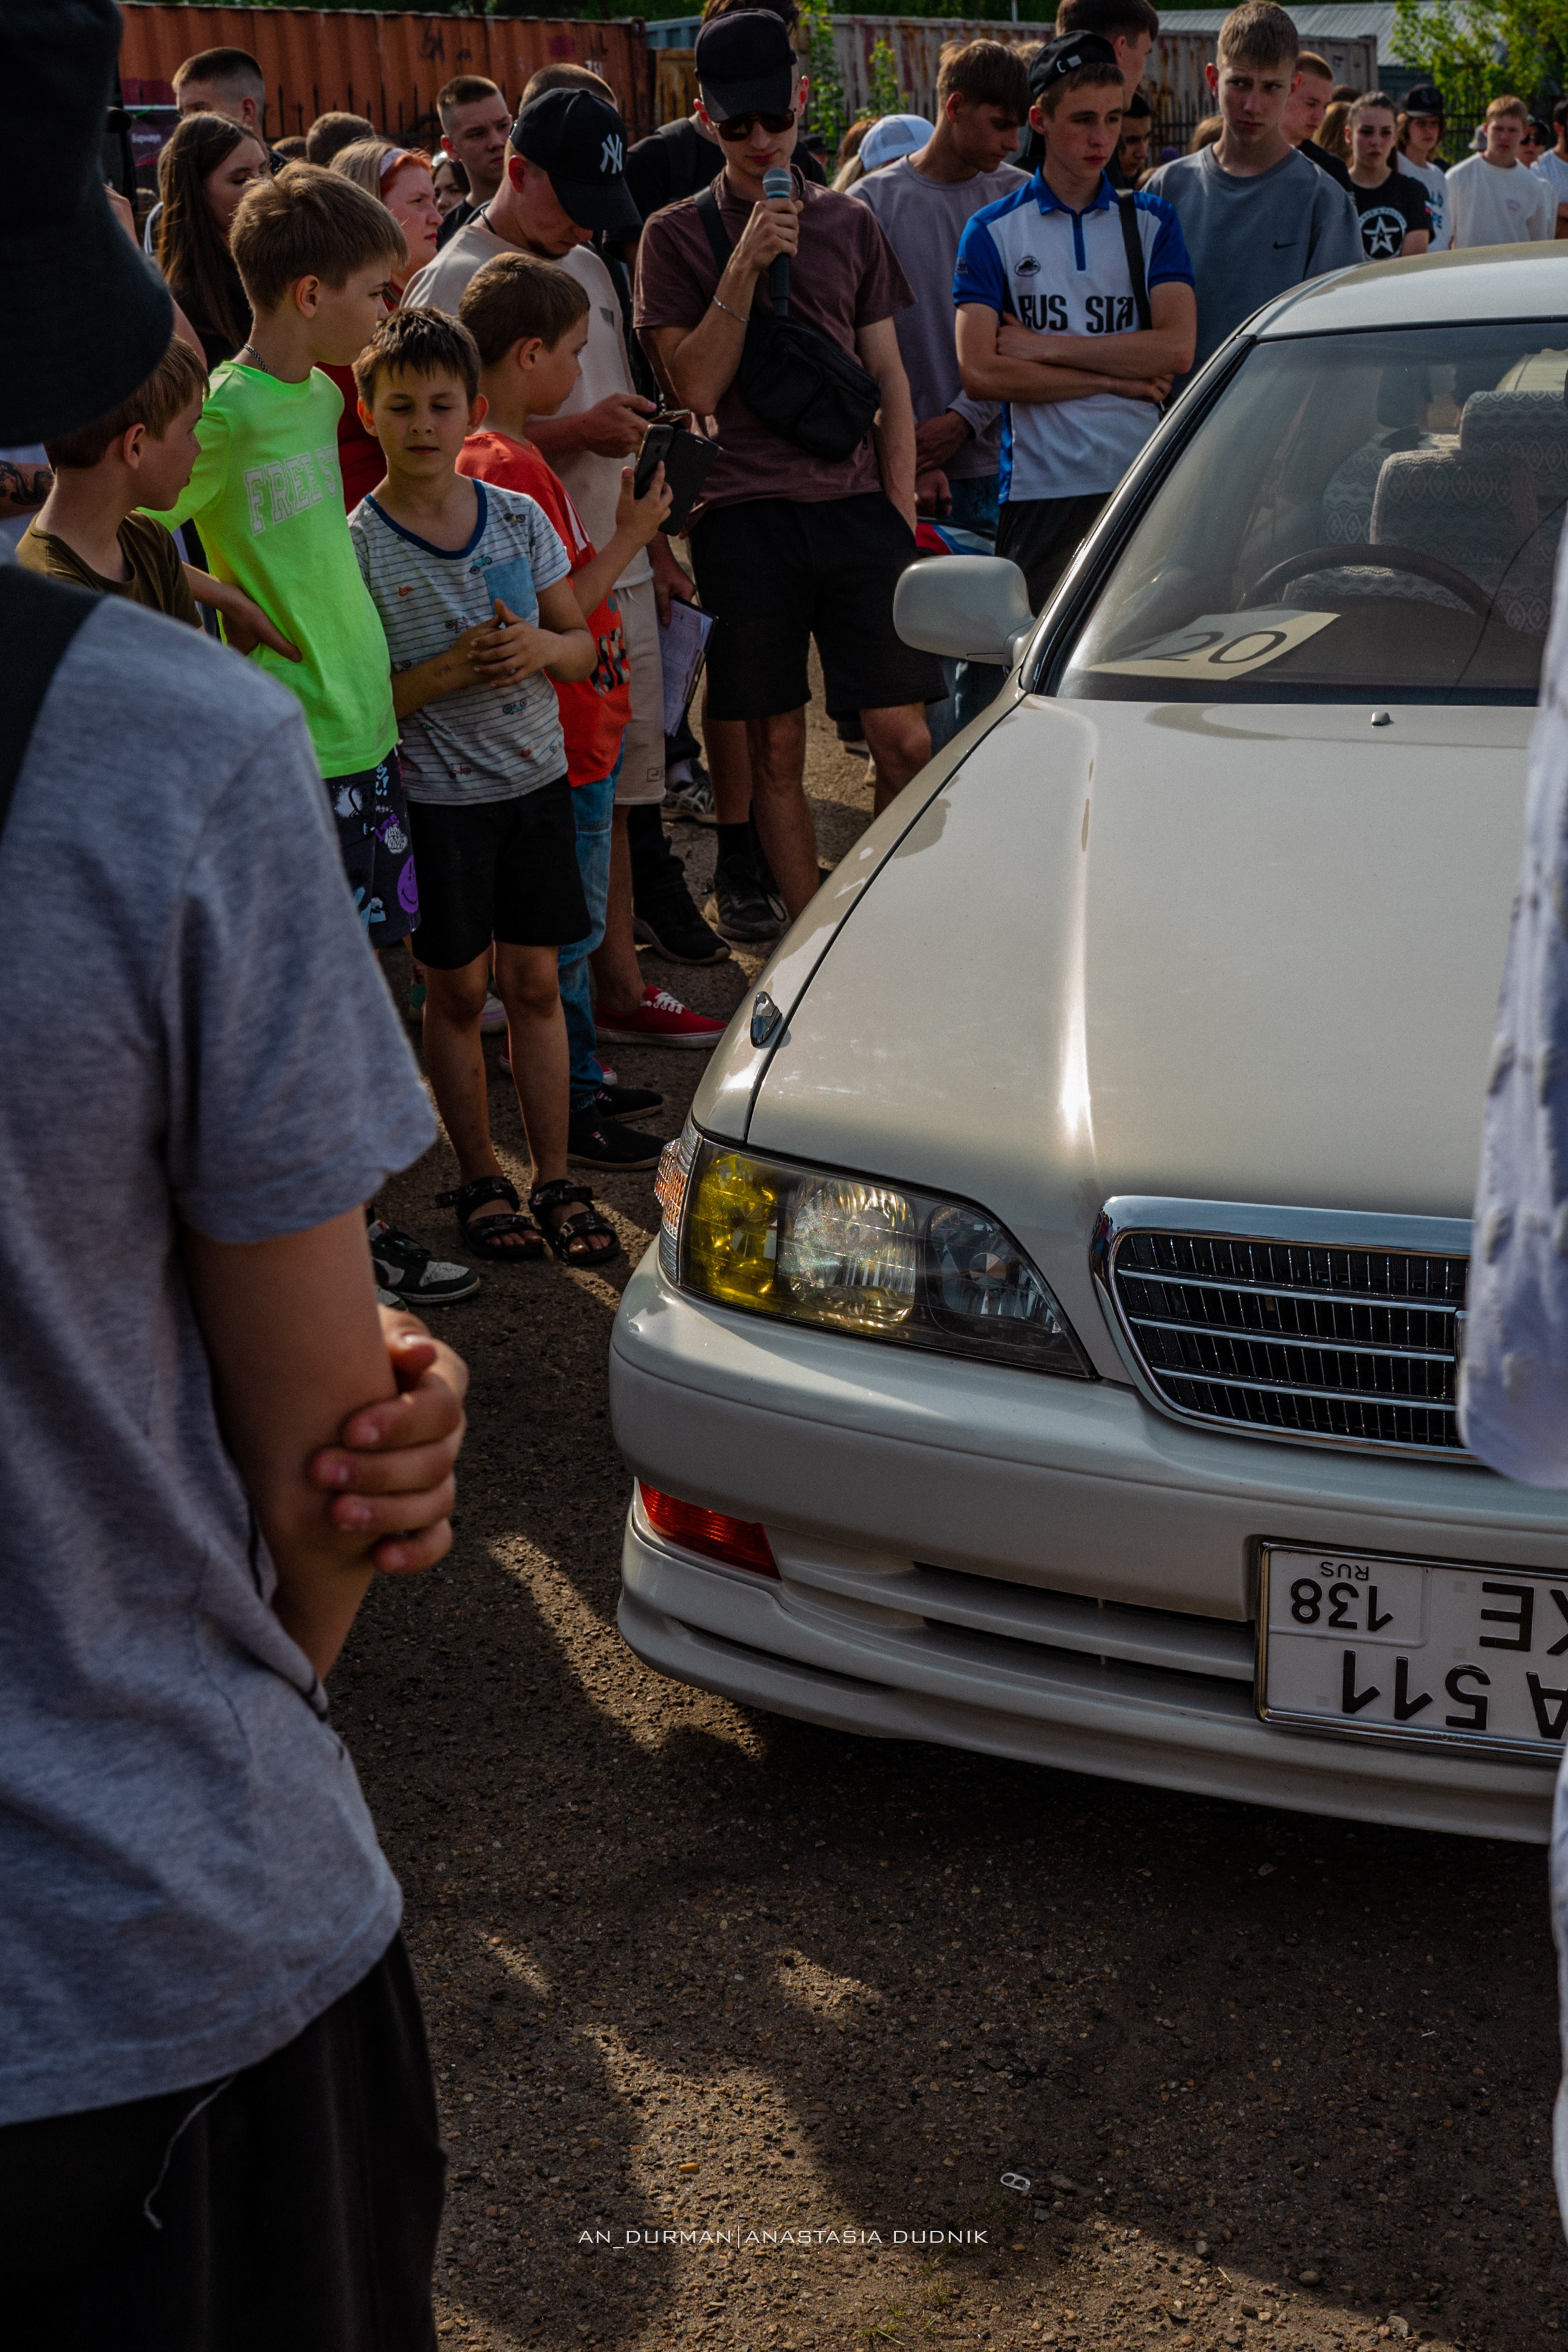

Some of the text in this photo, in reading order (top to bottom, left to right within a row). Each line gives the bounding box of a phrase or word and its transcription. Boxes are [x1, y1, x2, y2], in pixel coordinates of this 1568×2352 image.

[600, 133, 623, 174] NY
[1018, 294, 1068, 332] RUS
[242, 451, 324, 537] FREE
[1141, 630, 1288, 664] 20
[1320, 1561, 1370, 1581] RUS
[1290, 1577, 1394, 1632] 138
[1341, 1650, 1491, 1731] 511
